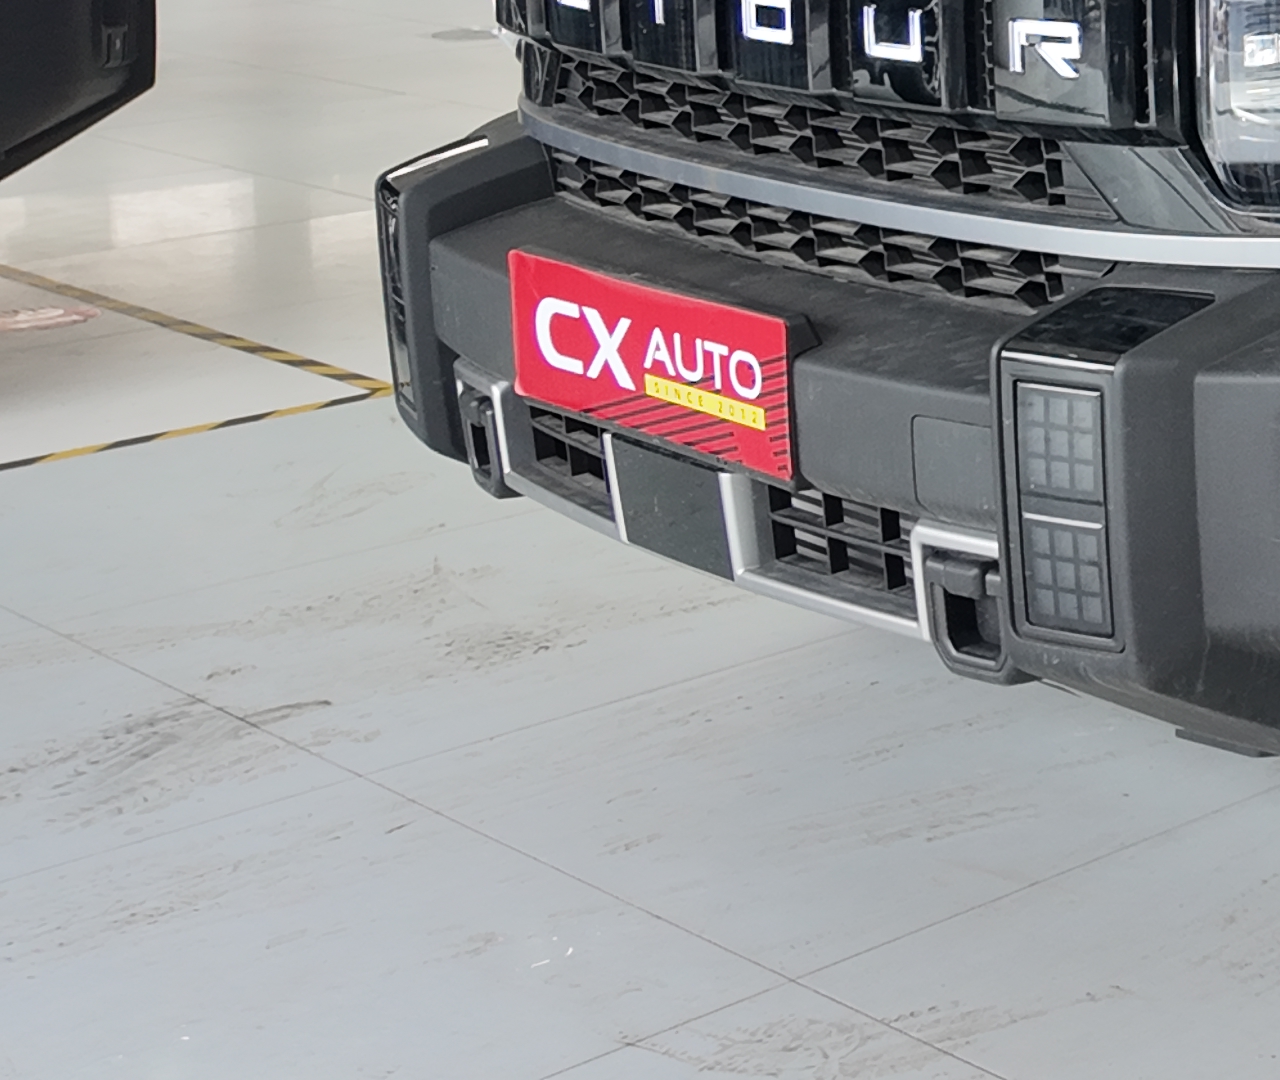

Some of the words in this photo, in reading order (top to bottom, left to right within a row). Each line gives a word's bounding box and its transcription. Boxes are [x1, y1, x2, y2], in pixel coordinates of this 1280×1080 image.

[534, 295, 637, 392] CX
[642, 324, 764, 400] AUTO
[650, 379, 707, 408] SINCE
[716, 397, 763, 427] 2012
